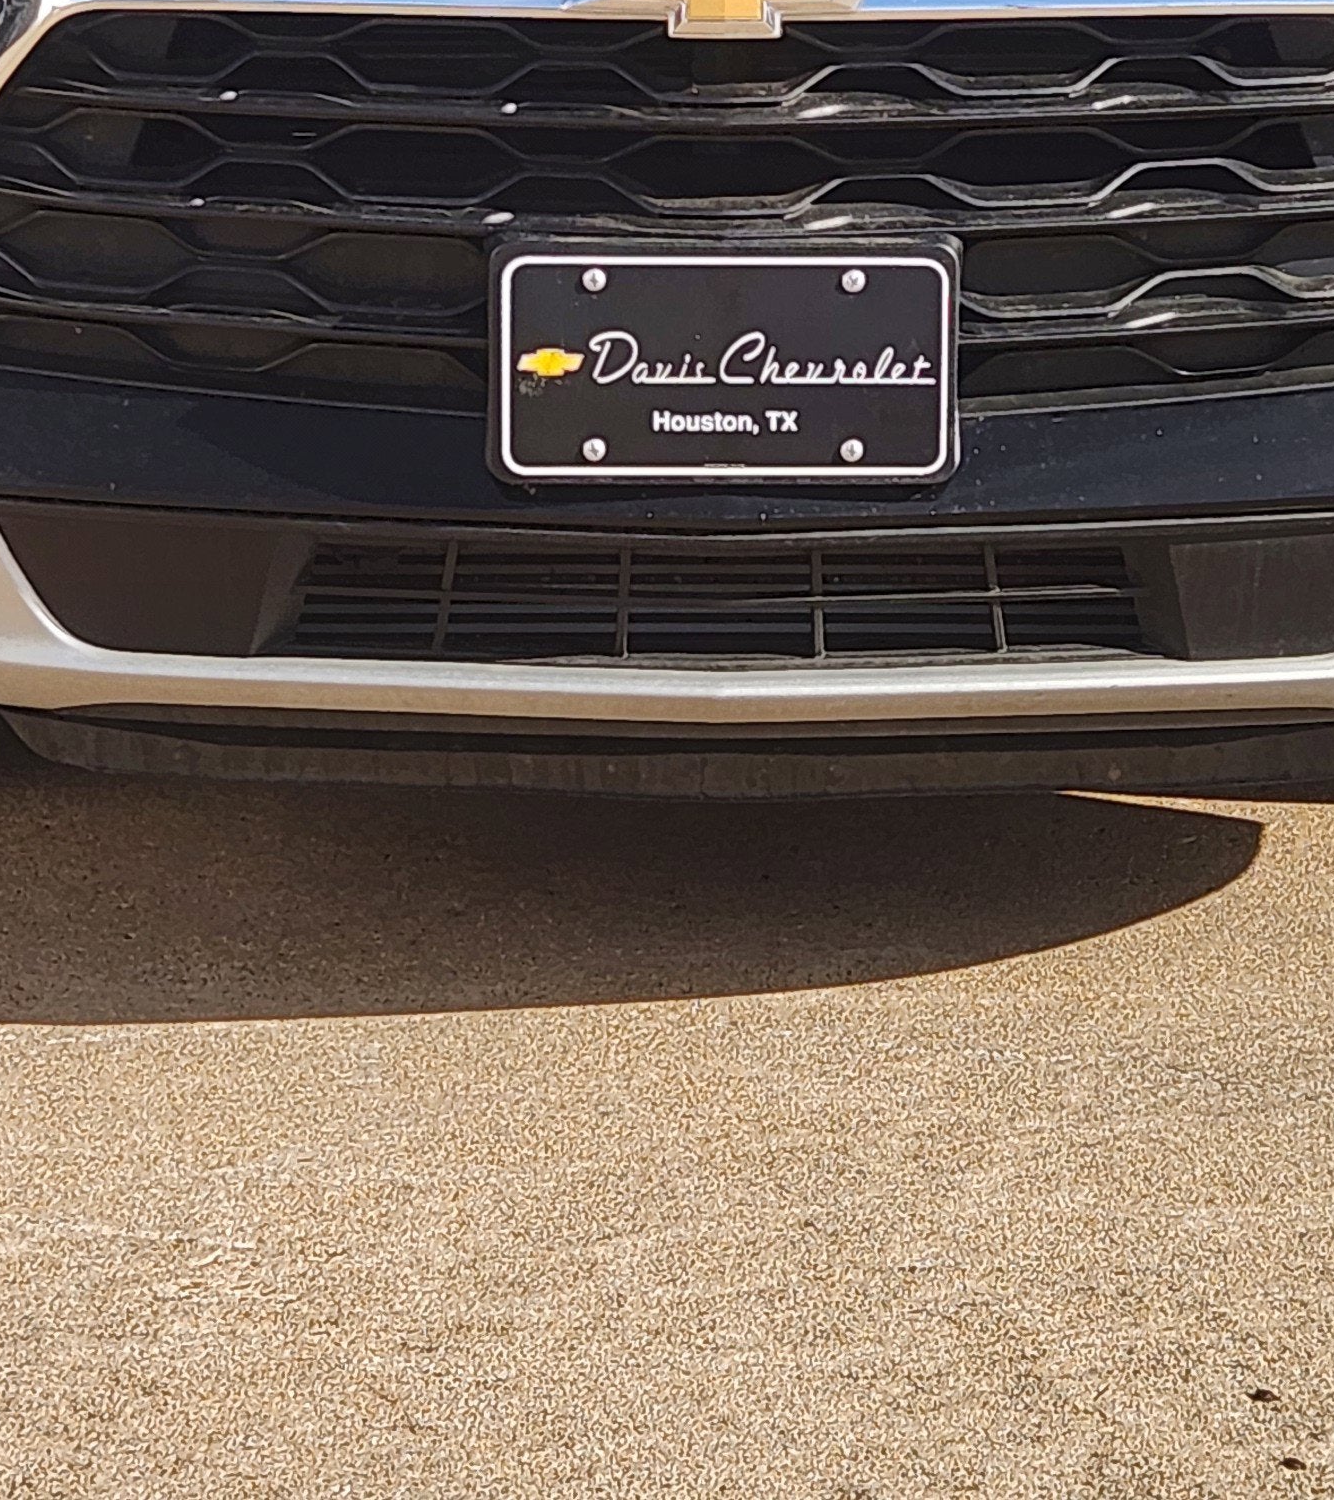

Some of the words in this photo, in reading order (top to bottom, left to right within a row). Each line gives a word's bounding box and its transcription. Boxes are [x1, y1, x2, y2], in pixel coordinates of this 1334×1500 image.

[589, 331, 716, 384] Davis
[719, 331, 937, 385] Chevrolet
[652, 410, 760, 435] Houston,
[765, 410, 798, 432] TX
